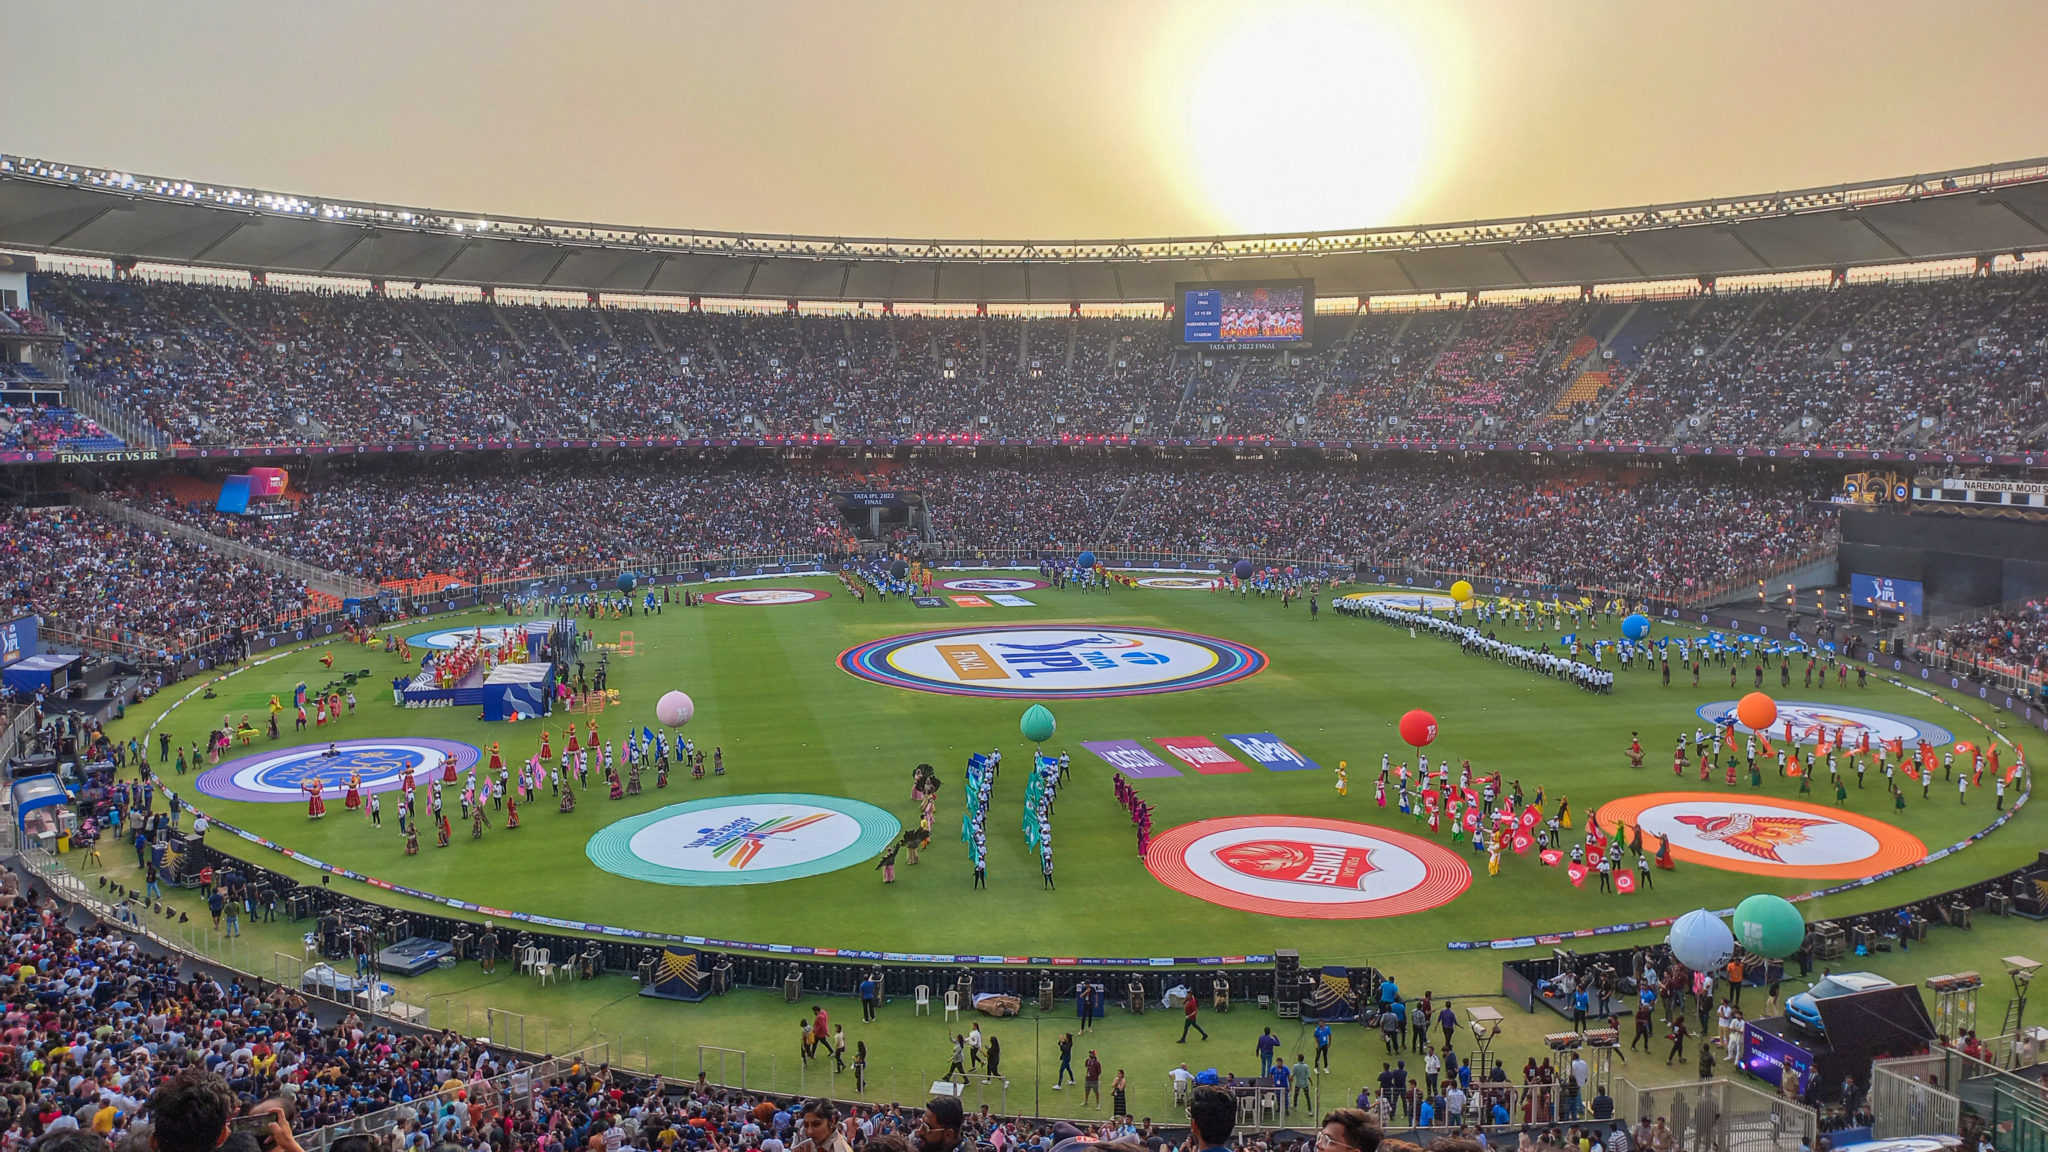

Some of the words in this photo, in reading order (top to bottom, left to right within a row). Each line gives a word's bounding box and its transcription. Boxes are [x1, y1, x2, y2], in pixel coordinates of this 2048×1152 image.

[61, 453, 97, 463] FINAL
[106, 453, 122, 461] GT
[125, 452, 139, 460] VS
[143, 451, 158, 460] RR
[1964, 481, 2014, 491] NARENDRA
[2016, 485, 2041, 493] MODI
[1882, 590, 1897, 602] IPL
[8, 637, 20, 652] IPL
[949, 650, 989, 671] FINAL
[1000, 651, 1092, 678] IPL
[1079, 651, 1119, 670] TATA
[1426, 724, 1437, 734] 15
[1228, 737, 1306, 767] RuPay
[1100, 745, 1165, 774] upstox
[1296, 845, 1348, 884] KINGS
[623, 929, 640, 937] RuPay
[1613, 924, 1629, 932] RuPay
[1742, 921, 1763, 939] 15
[837, 950, 857, 958] RuPay
[860, 951, 880, 959] RuPay
[1751, 1031, 1764, 1042] TATA
